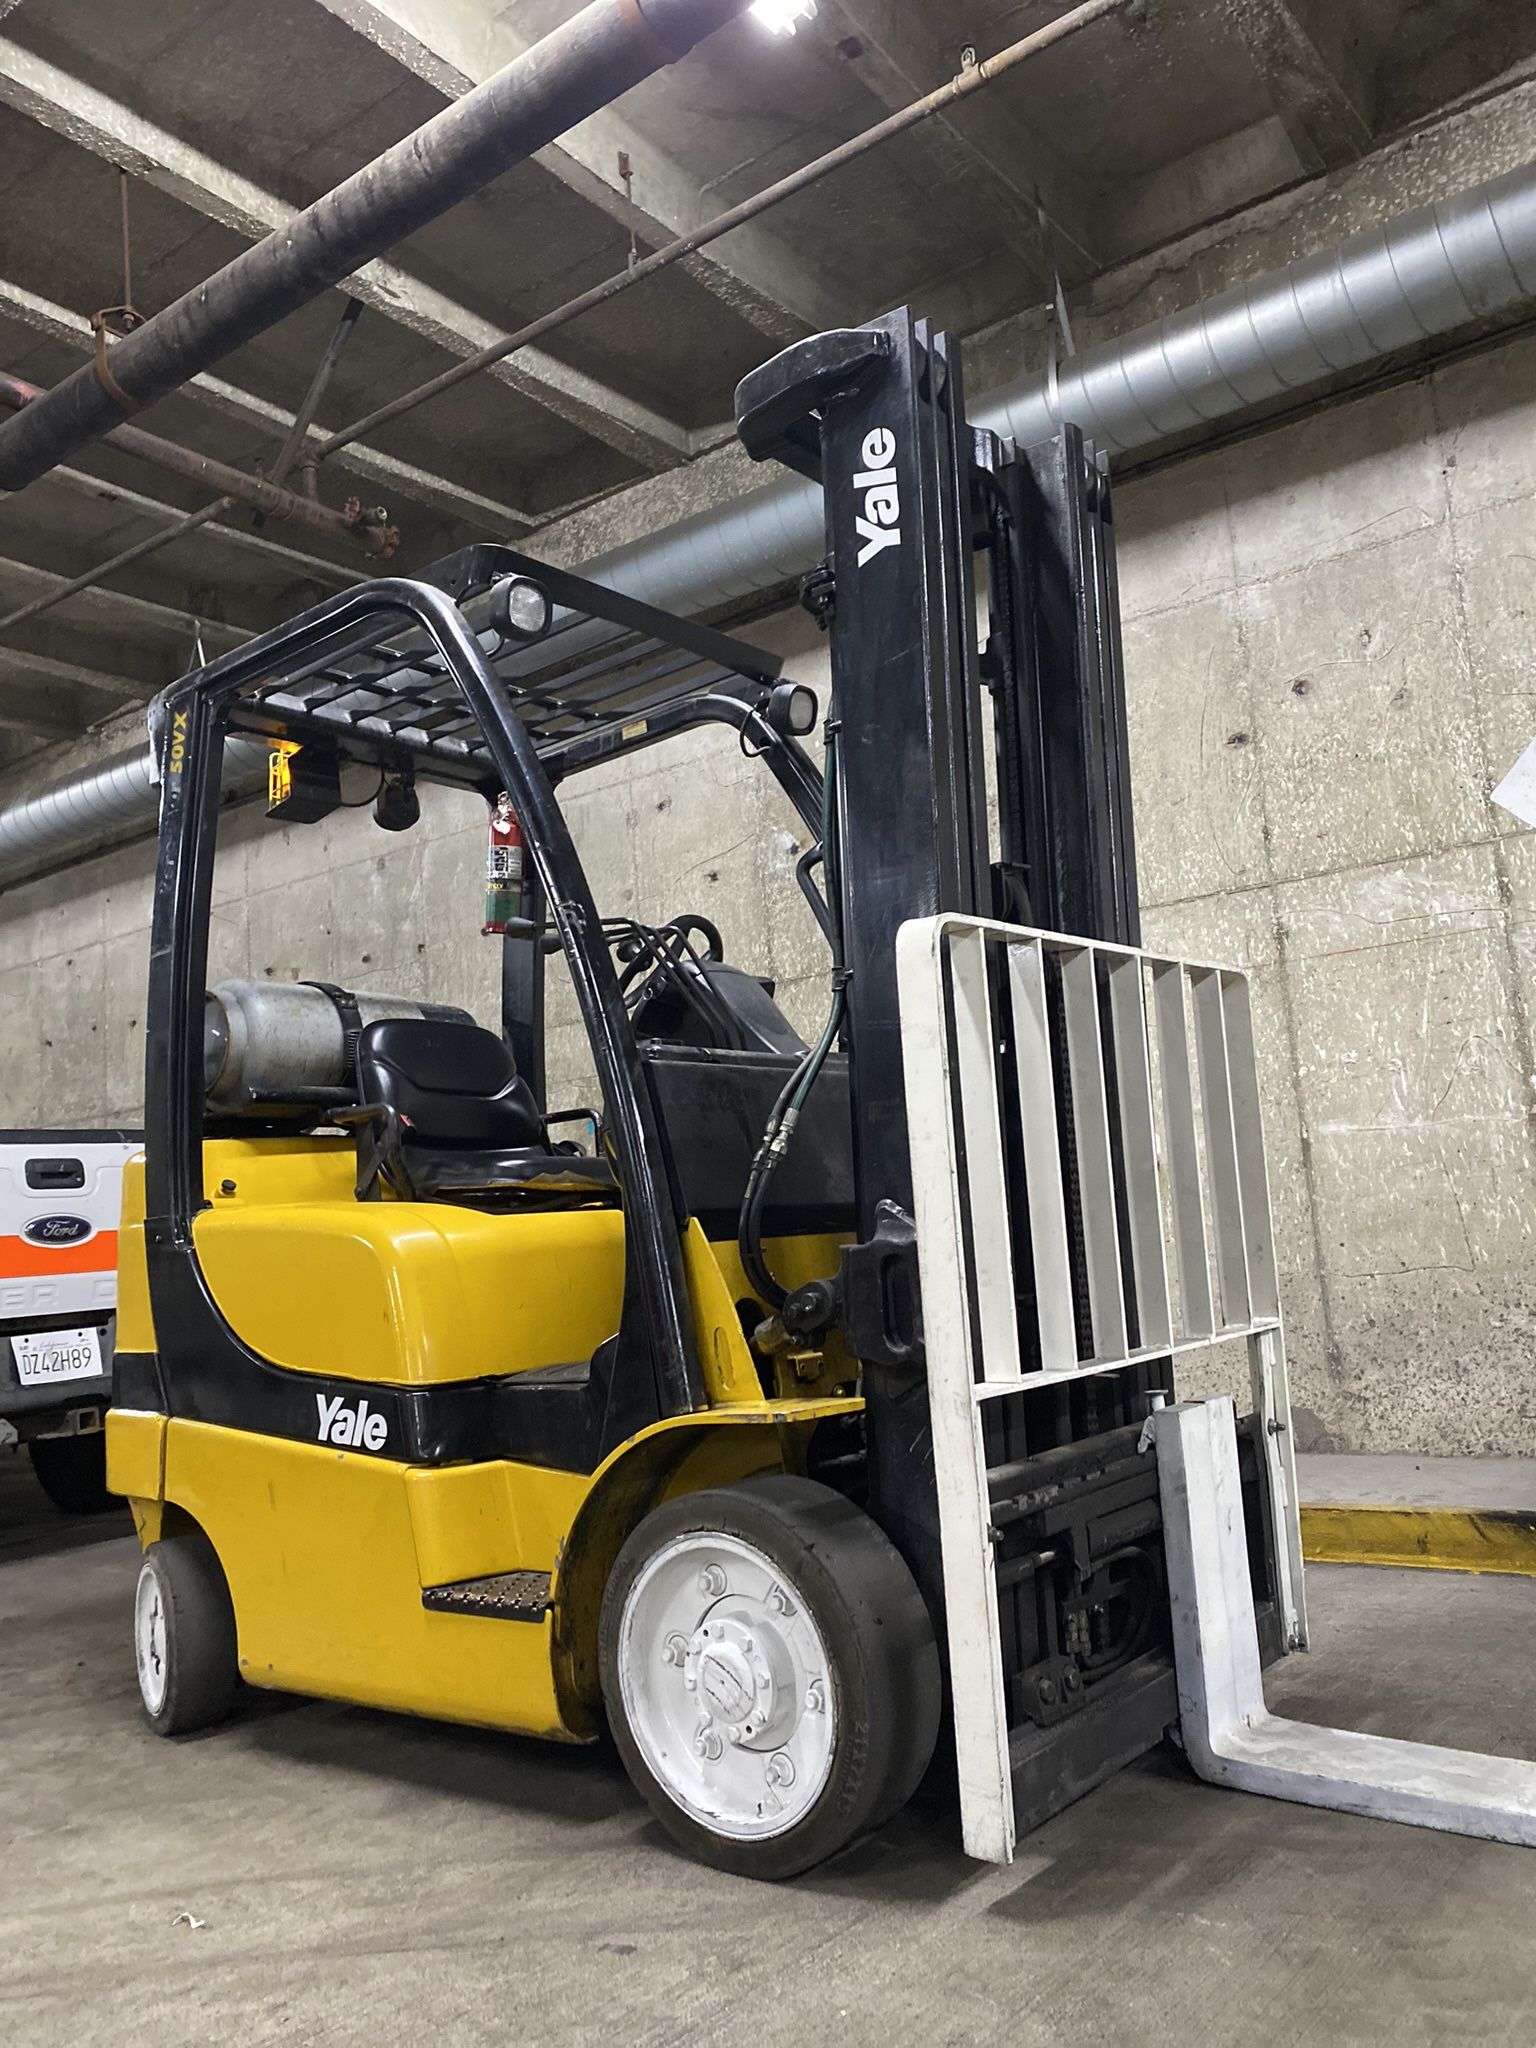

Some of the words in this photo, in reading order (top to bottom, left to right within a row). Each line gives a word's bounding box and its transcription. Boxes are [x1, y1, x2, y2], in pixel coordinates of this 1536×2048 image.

[853, 427, 901, 568] Yale
[169, 711, 188, 774] 50VX
[43, 1220, 79, 1237] Ford
[22, 1347, 92, 1375] DZ42H89
[316, 1393, 388, 1451] Yale
